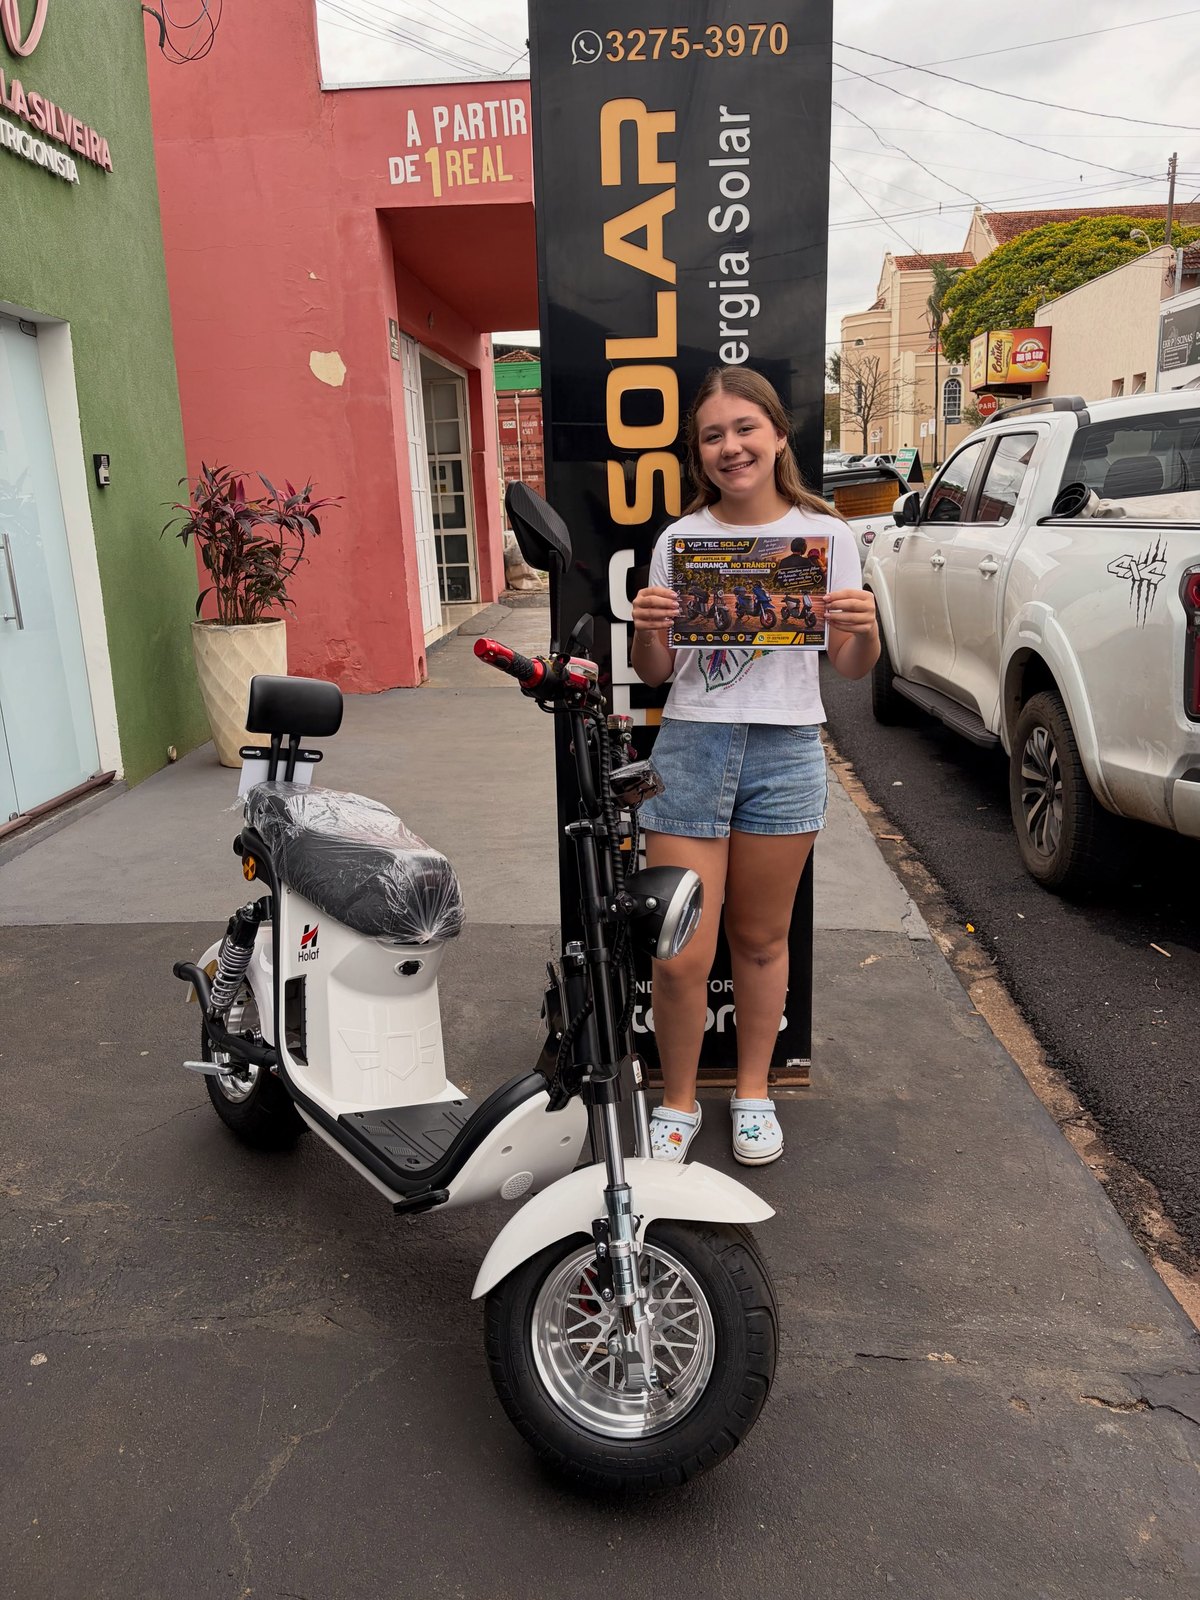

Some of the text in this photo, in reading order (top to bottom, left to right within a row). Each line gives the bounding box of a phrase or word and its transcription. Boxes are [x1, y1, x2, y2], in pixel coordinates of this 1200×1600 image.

[605, 22, 789, 62] 3275-3970
[406, 98, 527, 148] A PARTIR
[388, 145, 513, 197] DE 1 REAL
[708, 105, 760, 365] ergia Solar
[600, 97, 681, 526] SOLAR
[979, 401, 996, 410] PARE
[685, 562, 729, 570] SEGURANÇA
[743, 561, 777, 569] TRÂNSITO
[298, 948, 320, 962] Holaf
